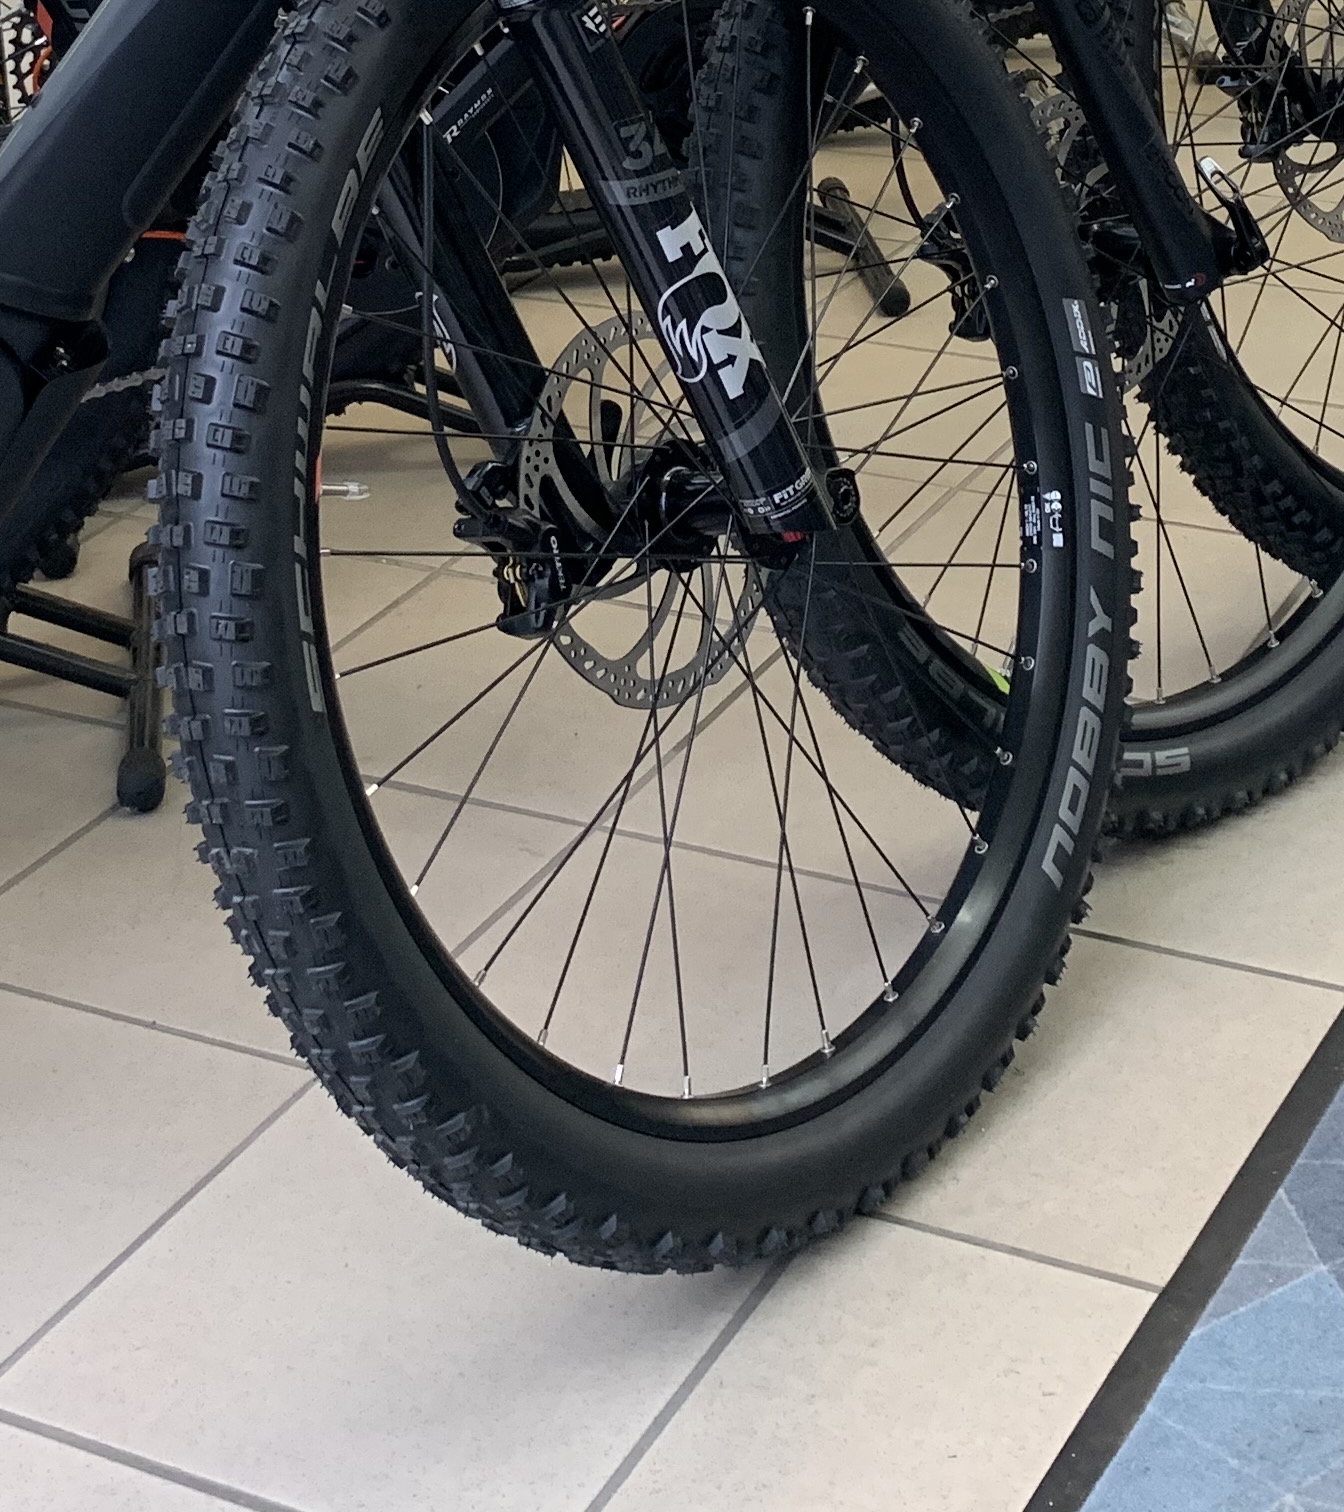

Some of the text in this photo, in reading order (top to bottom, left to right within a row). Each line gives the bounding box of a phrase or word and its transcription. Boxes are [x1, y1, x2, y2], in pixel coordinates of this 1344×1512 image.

[293, 106, 383, 714] SCHWALBE
[656, 201, 767, 400] FOX
[1042, 422, 1115, 890] NOBBY NIC
